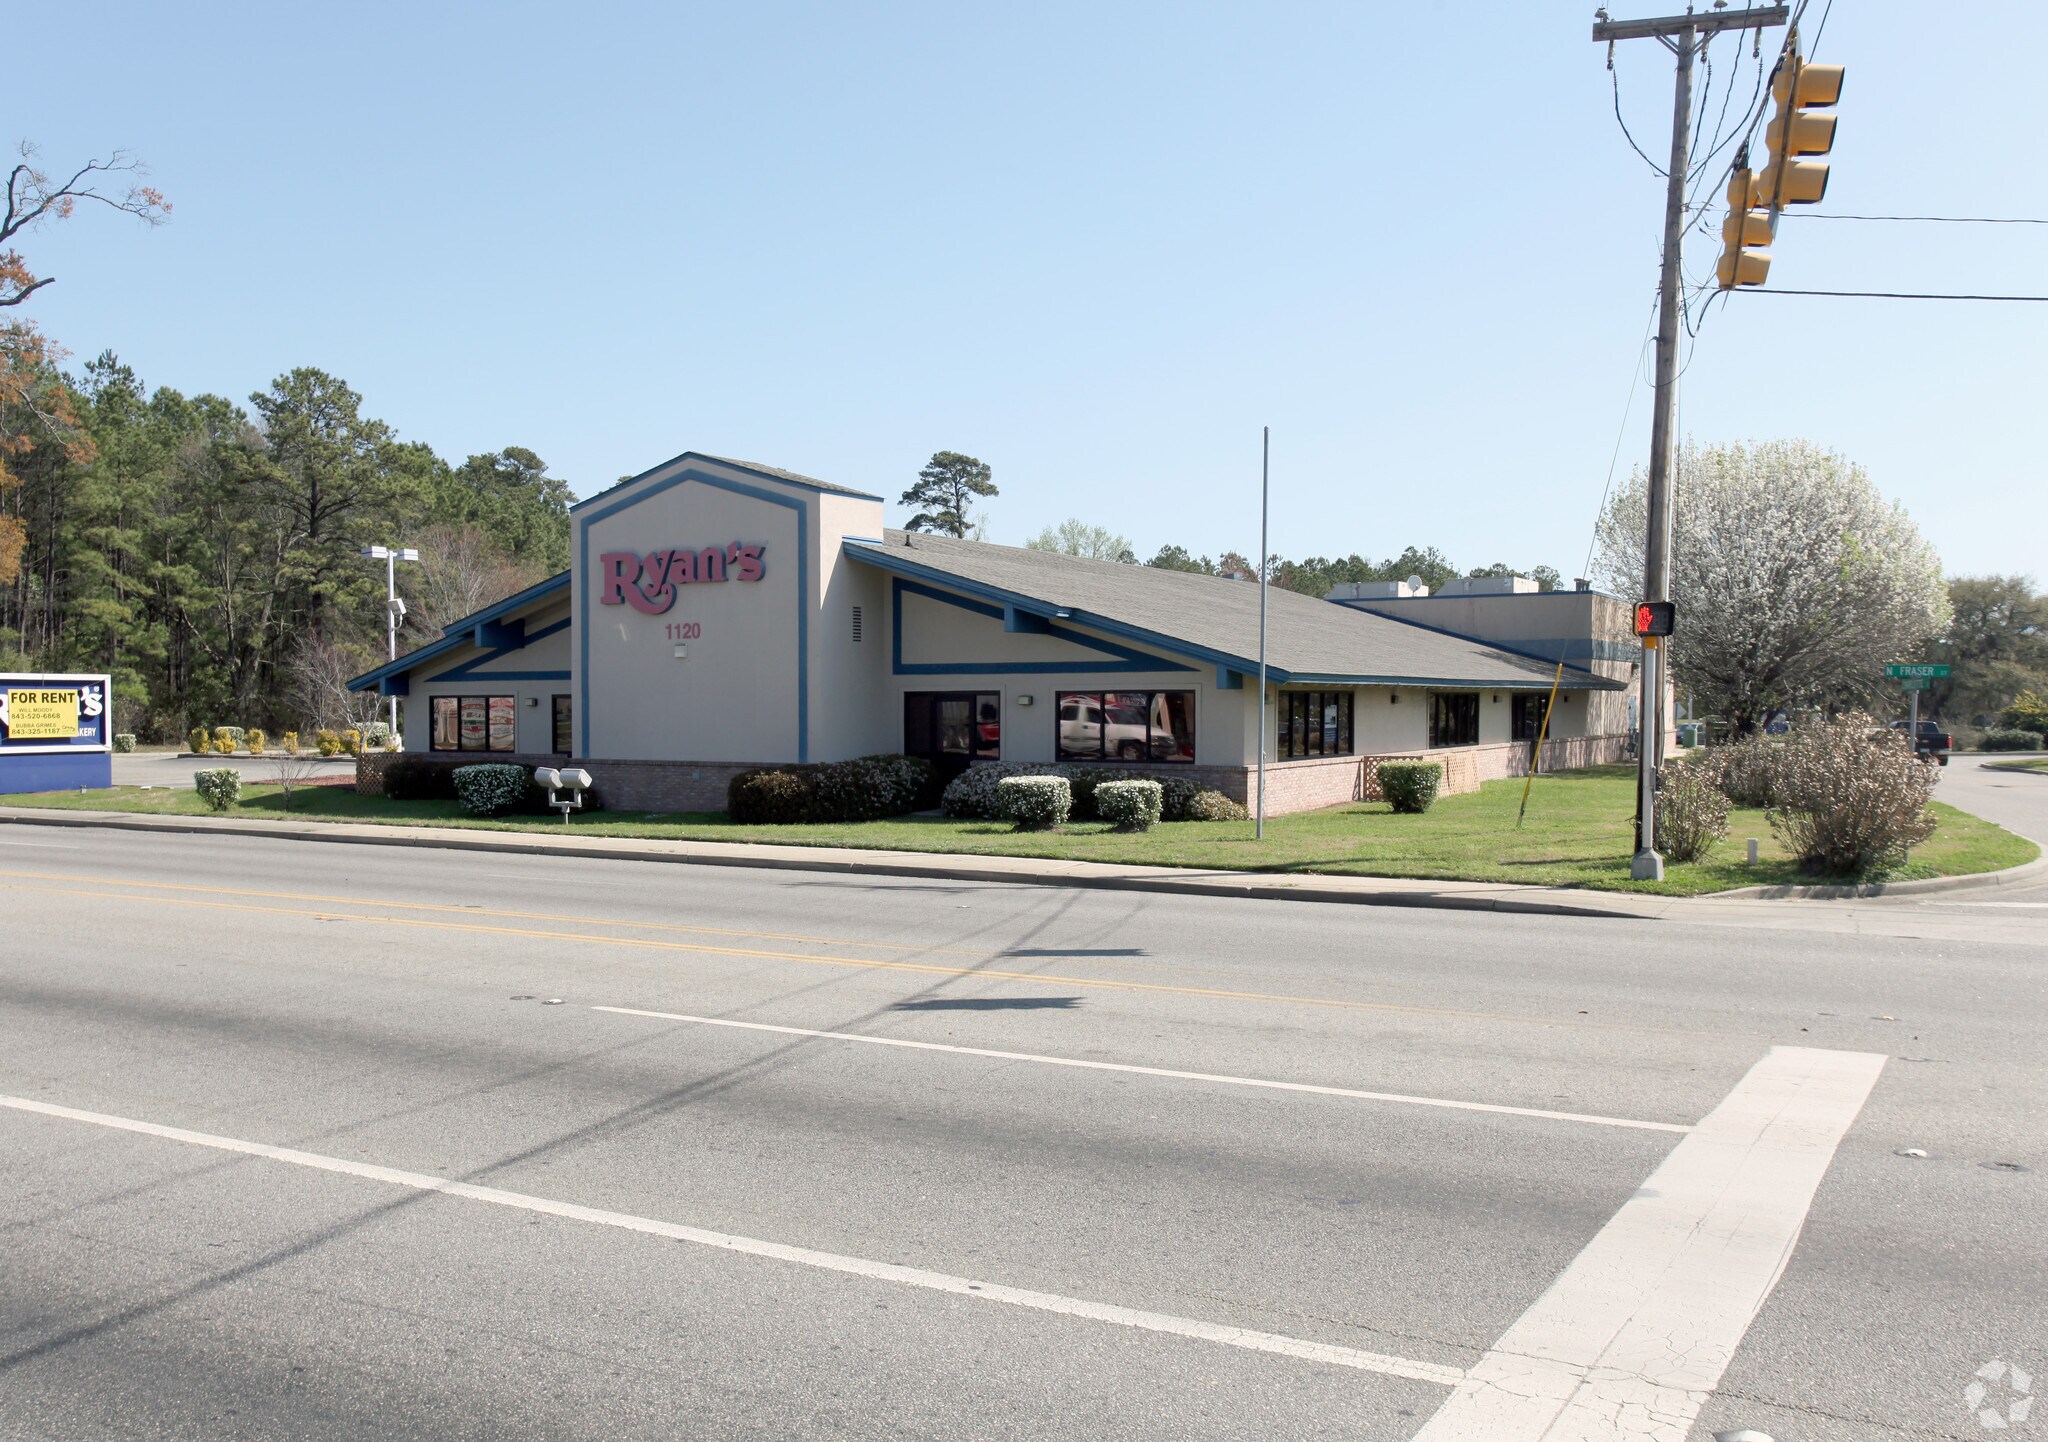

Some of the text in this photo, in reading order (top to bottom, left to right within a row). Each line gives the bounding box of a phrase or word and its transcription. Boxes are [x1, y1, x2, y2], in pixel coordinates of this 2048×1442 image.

[600, 540, 767, 615] Ryan's
[665, 622, 701, 640] 1120
[1886, 666, 1893, 676] N
[1900, 666, 1934, 676] FRASER
[11, 692, 75, 704] FOR RENT
